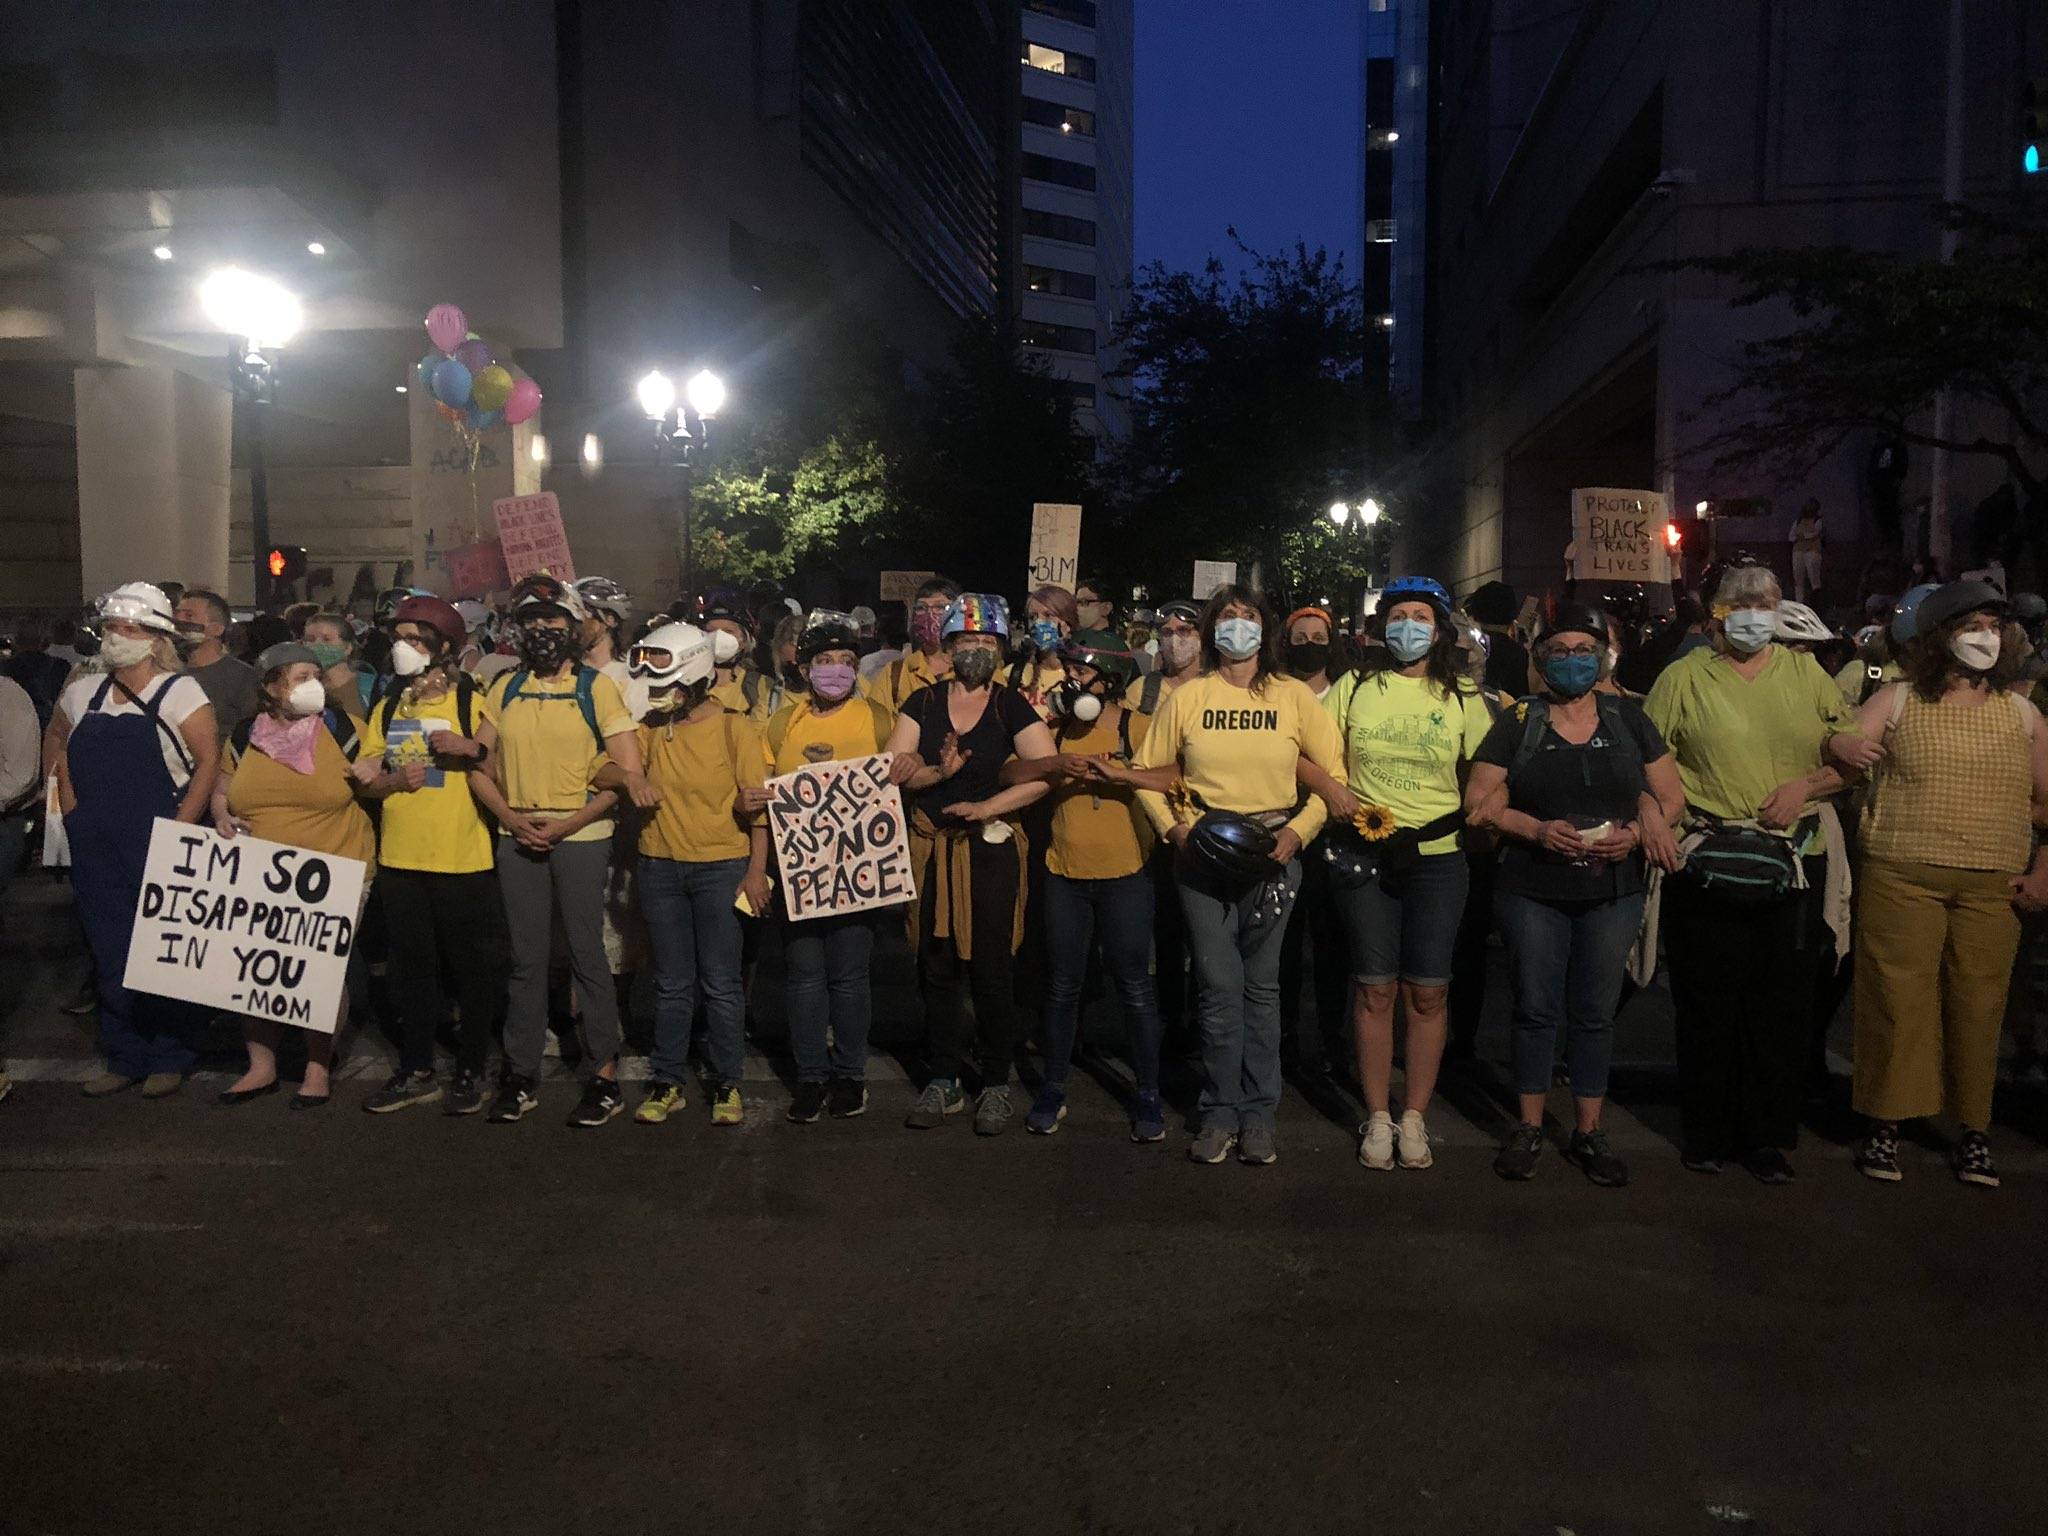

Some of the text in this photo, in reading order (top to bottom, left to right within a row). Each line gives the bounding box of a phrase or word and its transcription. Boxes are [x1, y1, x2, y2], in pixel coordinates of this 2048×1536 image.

[1590, 517, 1651, 540] BLACK
[1592, 541, 1650, 554] TRANS
[1035, 556, 1074, 583] BLM
[1594, 557, 1650, 573] LIVES
[1202, 709, 1278, 730] OREGON
[1354, 727, 1421, 792] WE ARE OREGON
[772, 757, 892, 870] NO JUSTICE
[835, 811, 896, 864] NO
[173, 832, 331, 904] I'M SO
[789, 852, 903, 914] PEACE
[142, 882, 352, 957] DISAPPOINTED
[157, 933, 306, 989] IN YOU
[231, 989, 310, 1023] -MOM
[600, 1095, 614, 1109] N
